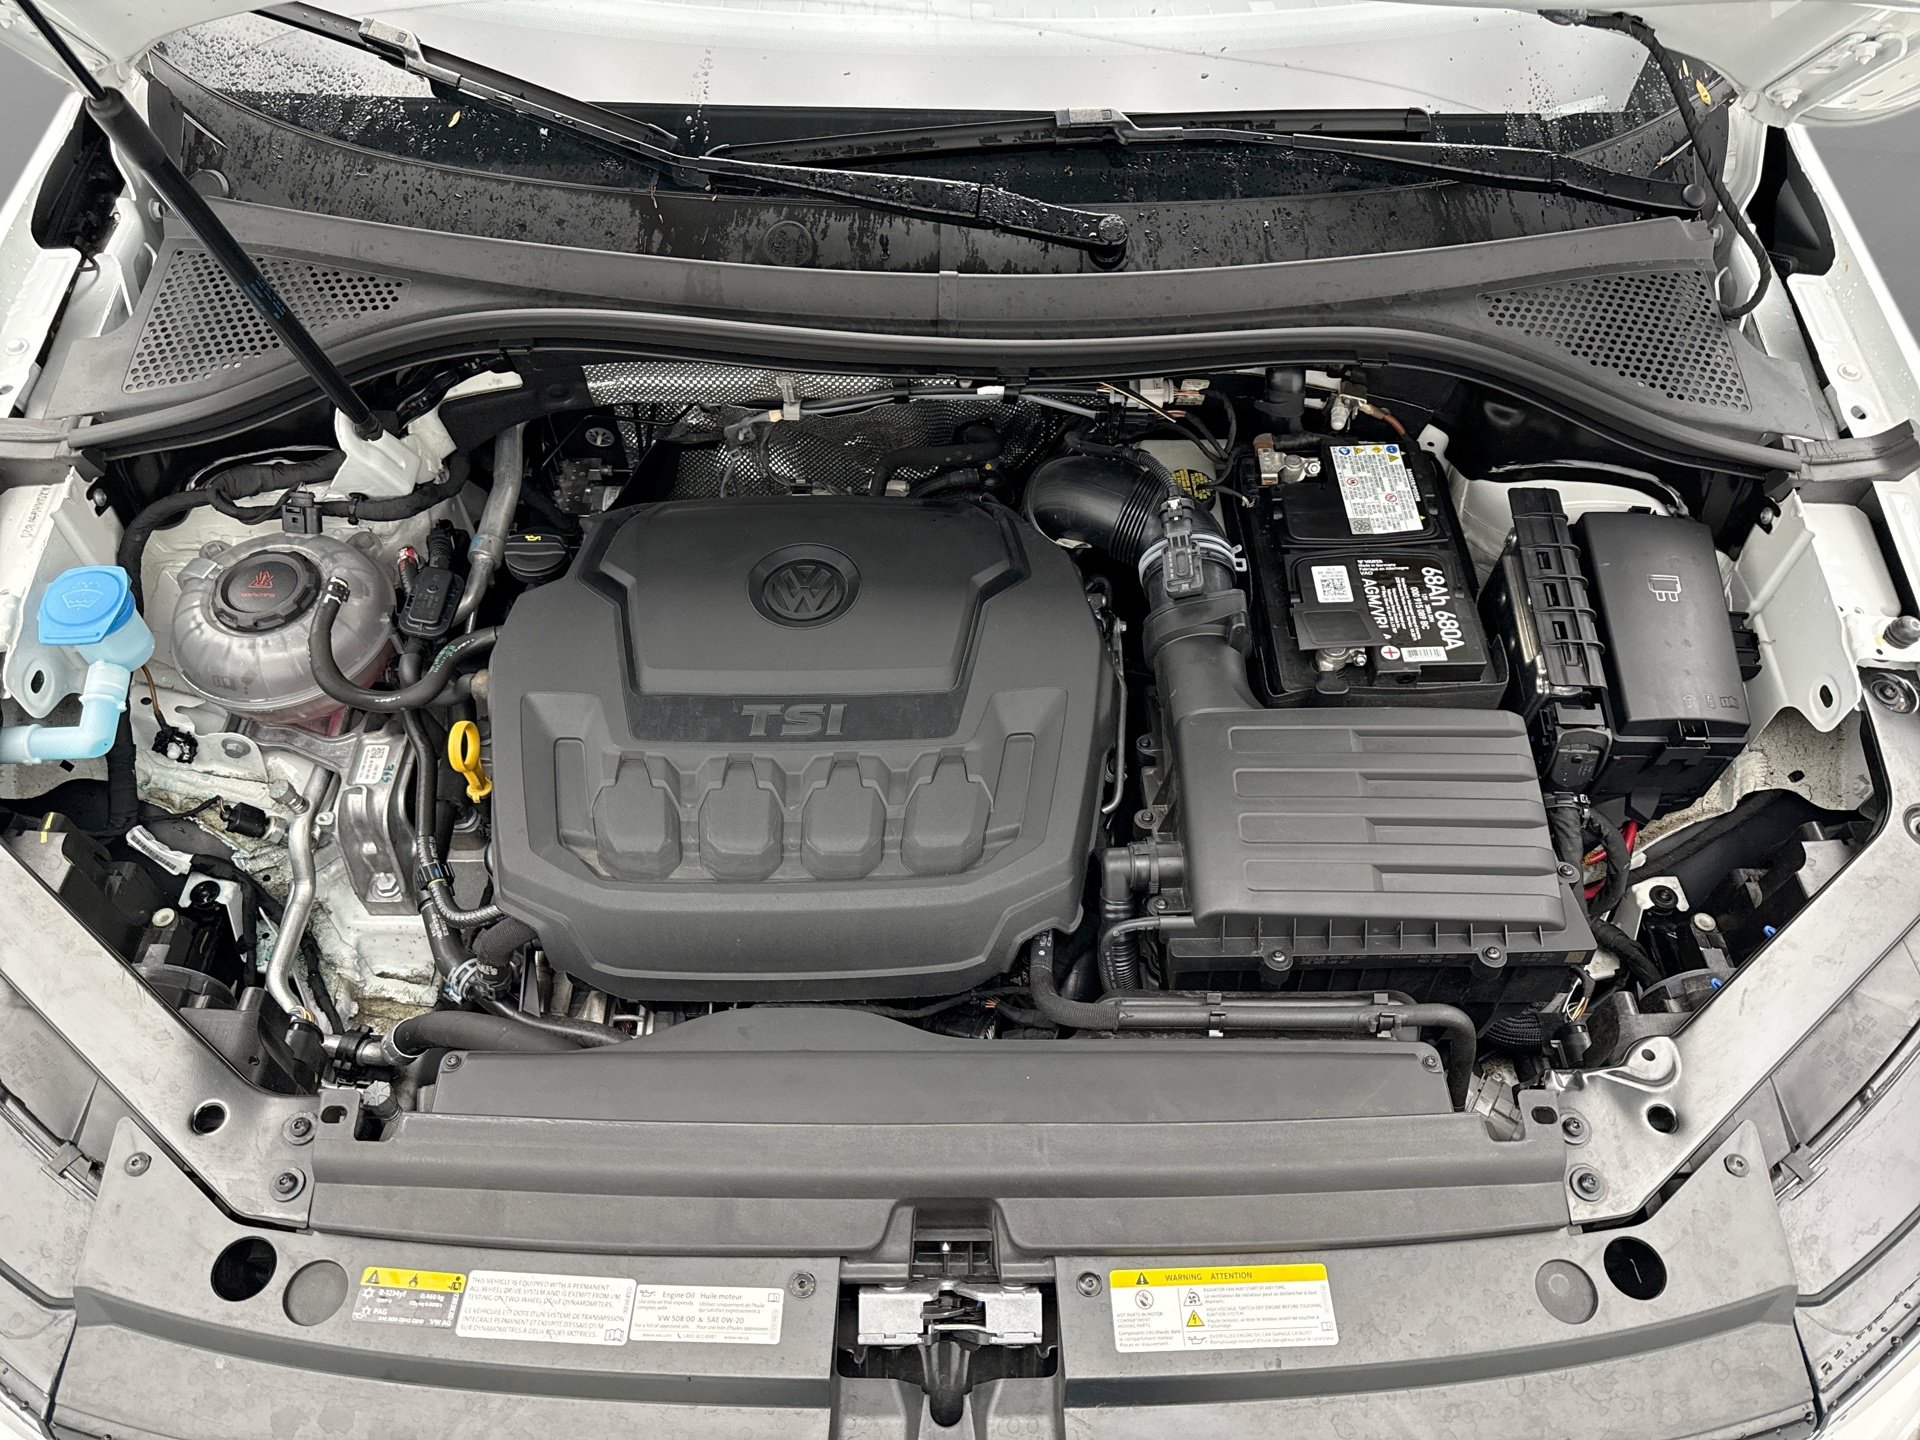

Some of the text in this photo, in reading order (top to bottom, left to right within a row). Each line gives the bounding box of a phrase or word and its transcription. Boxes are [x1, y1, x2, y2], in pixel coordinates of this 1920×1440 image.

[1421, 567, 1465, 651] 68Ah 680A
[741, 703, 846, 736] TSI
[1164, 1272, 1252, 1282] WARNING ATTENTION
[662, 1291, 685, 1300] Engine
